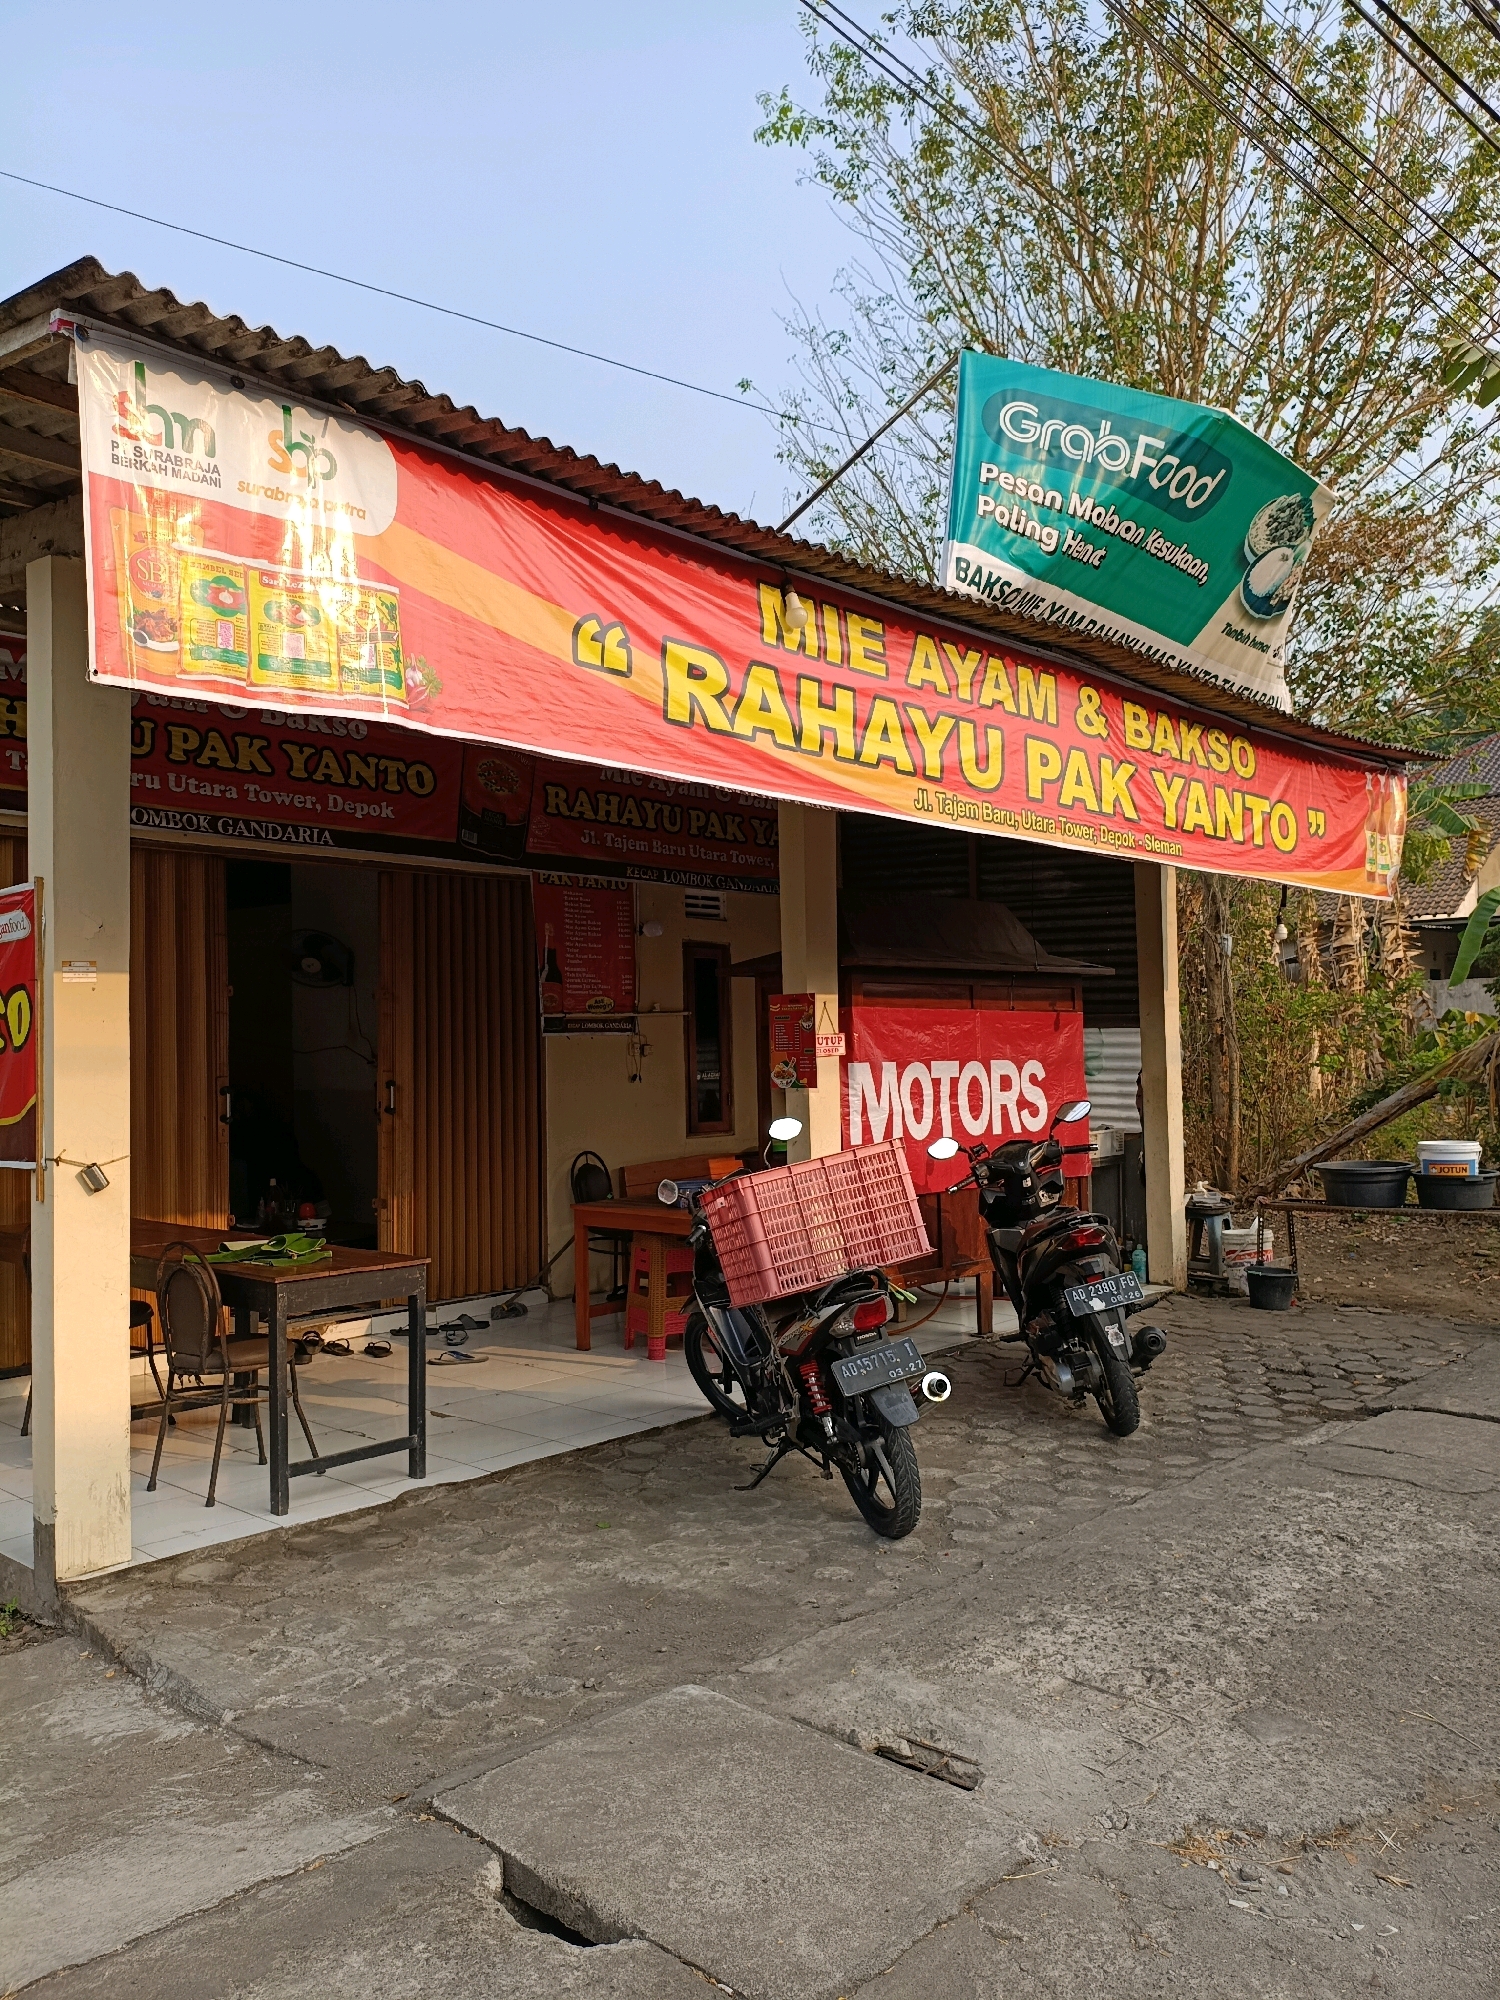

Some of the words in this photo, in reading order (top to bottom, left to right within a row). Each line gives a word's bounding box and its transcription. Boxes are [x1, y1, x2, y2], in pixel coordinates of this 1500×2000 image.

[111, 453, 168, 476] BERKAH
[171, 466, 222, 489] MADANI
[133, 445, 221, 477] SURABRAJA
[999, 401, 1227, 509] GrabFood
[977, 494, 1059, 553] Paling
[980, 462, 1063, 509] Pesan
[1142, 528, 1210, 587] Kesukaan,
[955, 557, 1022, 605] BAKSO
[757, 580, 888, 679] MIE
[905, 630, 1058, 727] AYAM
[1076, 683, 1110, 739] &
[1122, 697, 1258, 781] BAKSO
[168, 724, 272, 774] PAK
[283, 742, 435, 795] YANTO
[661, 636, 1004, 791] RAHAYU
[1024, 736, 1139, 822] PAK
[1148, 766, 1298, 854] YANTO
[168, 775, 238, 800] Utara
[243, 784, 322, 814] Tower,
[327, 794, 395, 820] Depok
[544, 784, 682, 833] RAHAYU
[690, 811, 746, 842] PAK
[131, 807, 214, 832] OMBOK
[217, 817, 334, 846] GANDARIA
[914, 789, 932, 812] Jl.
[937, 791, 979, 820] Tajem
[982, 801, 1018, 829] Baru,
[1021, 810, 1056, 834] Utara
[1058, 819, 1097, 845] Tower,
[1099, 827, 1136, 853] Depok
[1144, 836, 1183, 857] Sleman
[580, 830, 600, 846] Jl.
[604, 832, 649, 853] Tajem
[652, 840, 686, 857] Baru
[689, 845, 728, 863] Utara
[730, 850, 774, 869] Tower,
[538, 871, 573, 886] PAK
[626, 866, 659, 880] KECAP
[663, 868, 714, 888] LOMBOK
[817, 1036, 842, 1045] UTUP
[848, 1059, 1048, 1145] MOTORS
[1437, 1166, 1468, 1175] JOTUN
[1072, 1288, 1086, 1302] AD
[1088, 1280, 1116, 1297] 2380
[1120, 1275, 1135, 1289] FG
[857, 1332, 878, 1340] HONDA
[841, 1362, 858, 1378] AD
